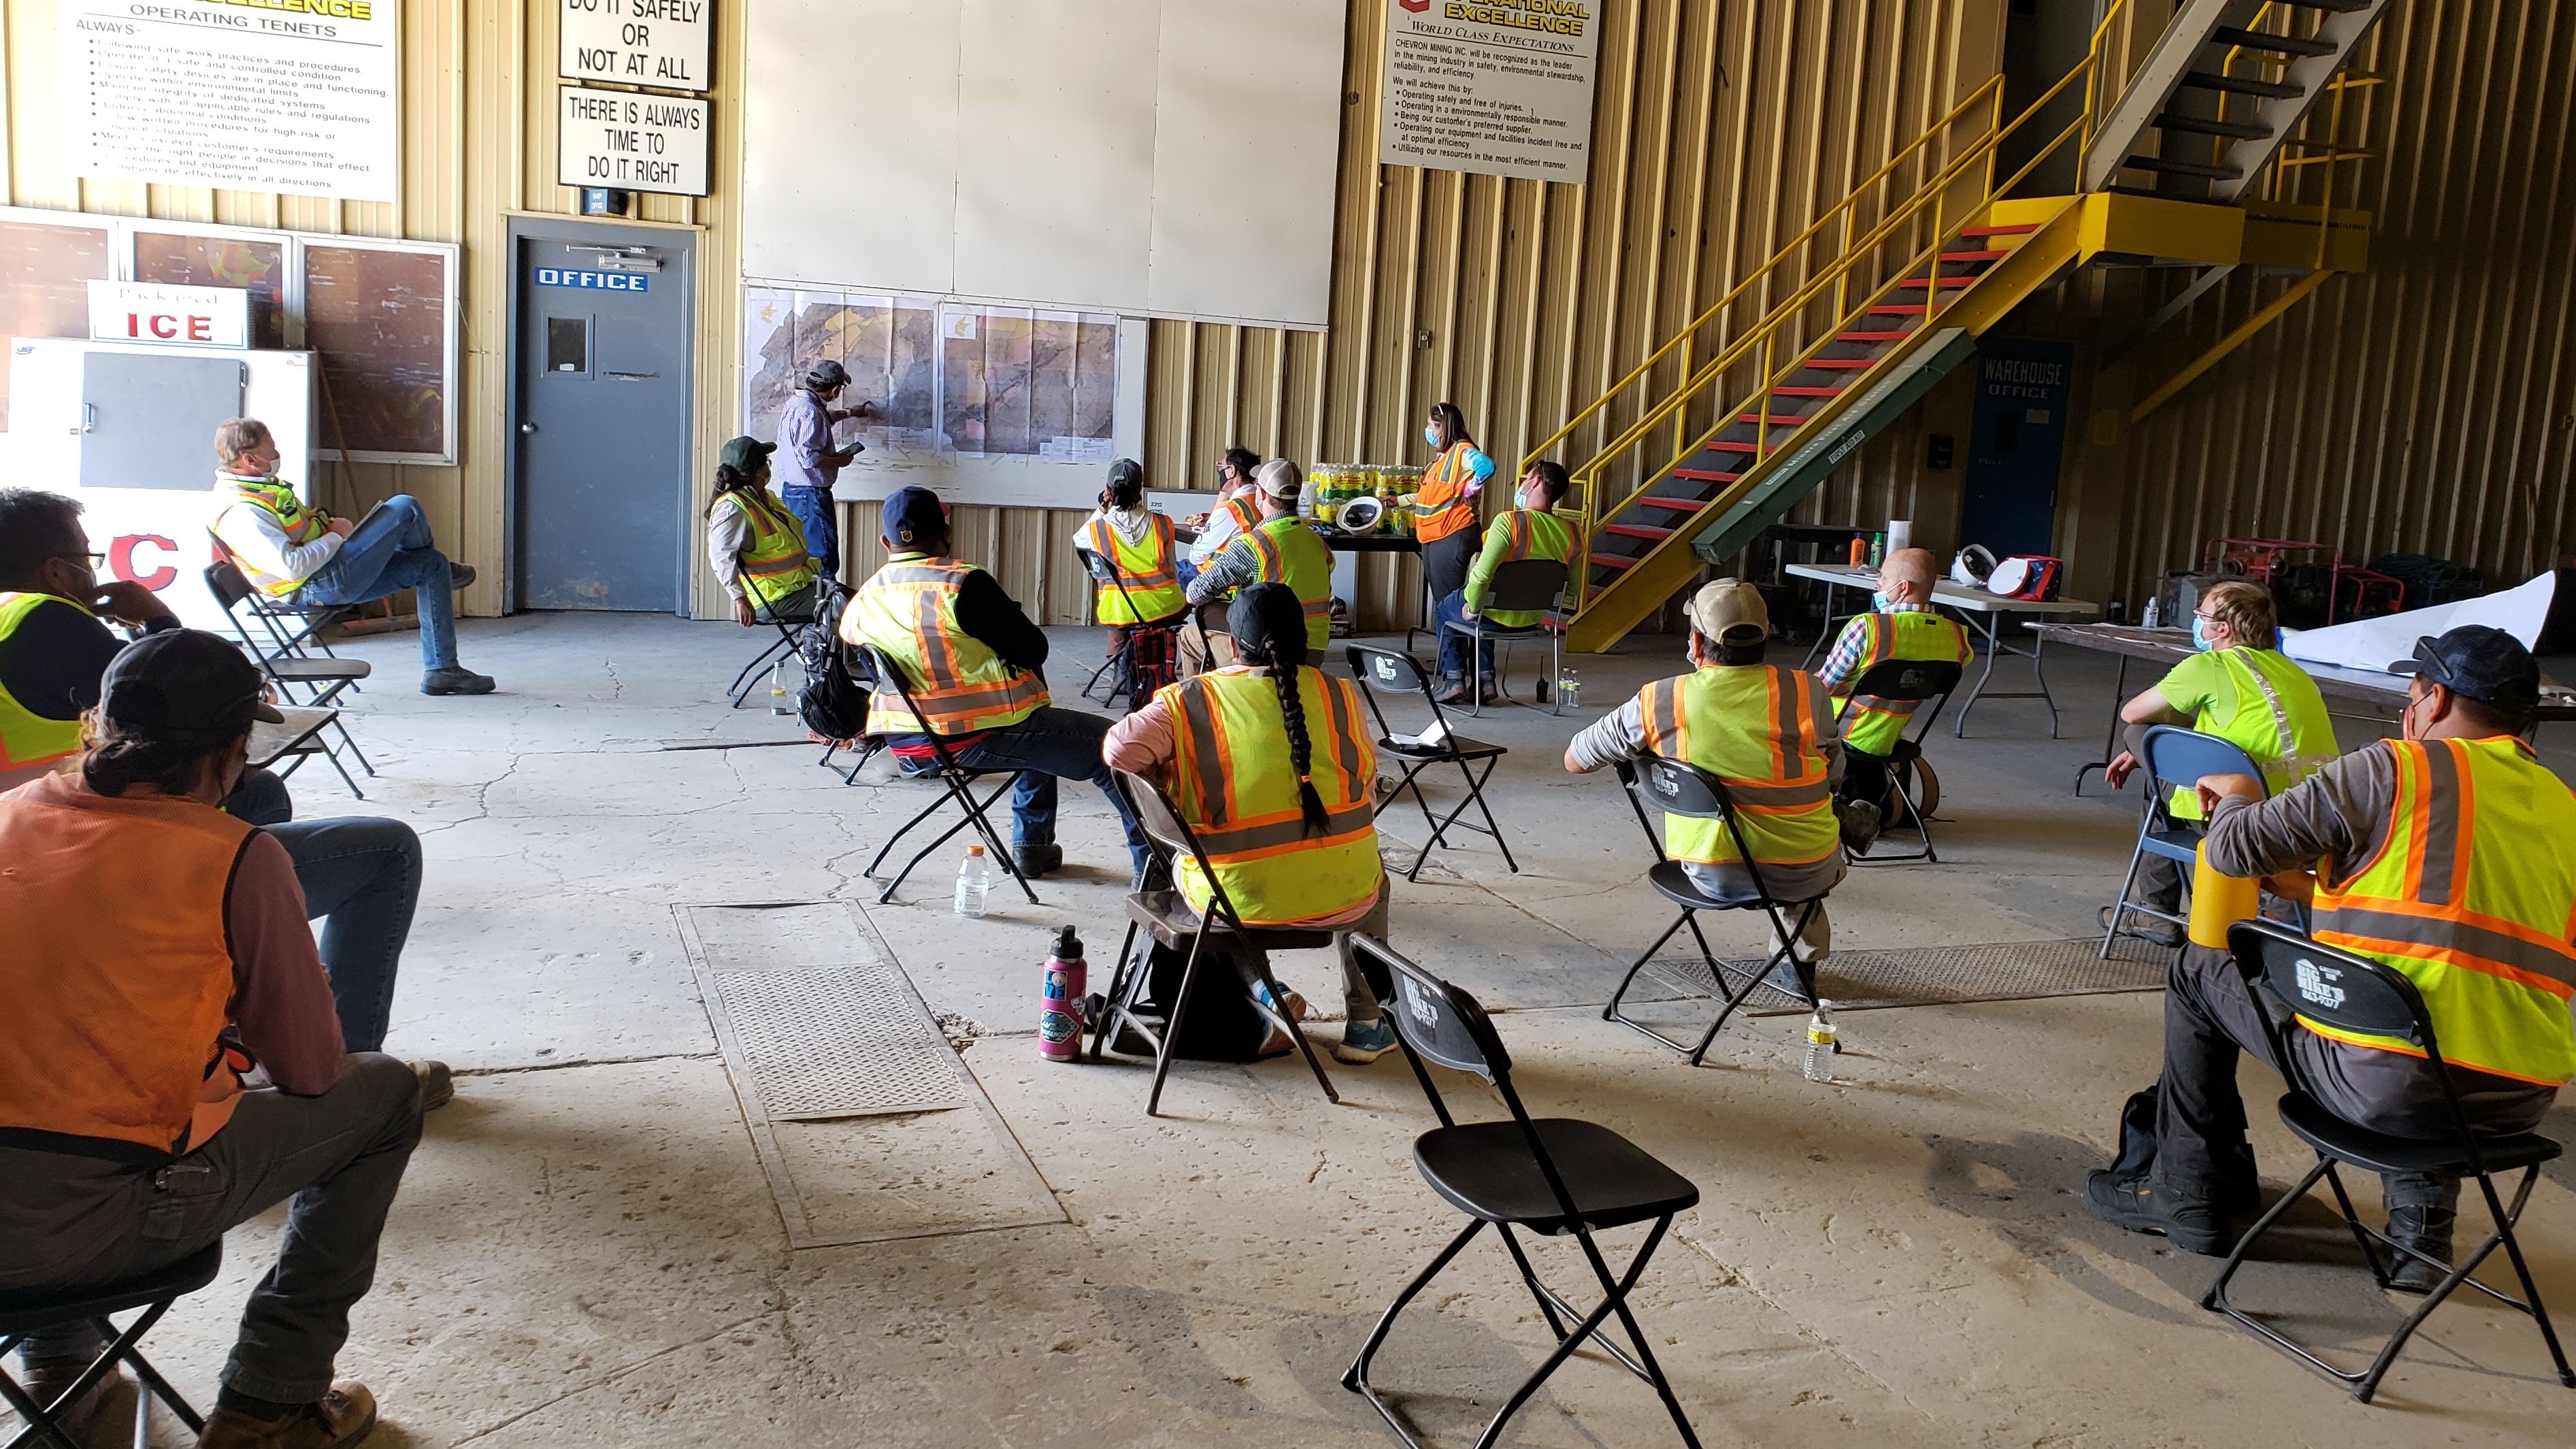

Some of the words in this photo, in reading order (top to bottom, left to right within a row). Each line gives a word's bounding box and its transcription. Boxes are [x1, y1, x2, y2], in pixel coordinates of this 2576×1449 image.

[130, 4, 248, 27] OPERATING
[258, 18, 337, 37] TENETS
[632, 0, 701, 24] SAFELY
[1444, 3, 1583, 37] EXCELLENCE
[622, 22, 649, 47] OR
[219, 54, 269, 63] practices
[578, 47, 618, 73] NOT
[626, 53, 648, 76] AT
[657, 56, 691, 81] ALL
[1395, 50, 1400, 58] in
[1404, 51, 1413, 60] the
[1417, 53, 1437, 64] mining
[1440, 56, 1466, 68] industry
[1468, 59, 1474, 68] in
[1501, 65, 1545, 76] environmental
[1396, 39, 1427, 50] CHEVRON
[1430, 44, 1452, 54] MINING
[1470, 49, 1480, 57] will
[1483, 50, 1490, 59] be
[1493, 54, 1528, 64] recognized
[1541, 59, 1550, 67] the
[1553, 60, 1572, 69] leader
[292, 71, 340, 80] condition
[1393, 76, 1403, 85] We
[1420, 81, 1445, 90] achieve
[1449, 84, 1460, 93] this
[188, 82, 265, 93] environmental
[271, 88, 298, 97] limits
[269, 79, 297, 87] place
[328, 84, 389, 97] functioning.
[1402, 90, 1434, 102] Operating
[1437, 95, 1457, 105] safely
[1474, 99, 1487, 107] free
[220, 94, 274, 104] dedicated
[281, 101, 325, 110] systems
[1402, 100, 1433, 113] Operating
[1436, 104, 1442, 112] in
[1451, 107, 1501, 121] environmentally
[1504, 114, 1540, 124] responsible
[312, 114, 369, 123] regulations
[569, 96, 617, 122] THERE
[625, 102, 638, 124] IS
[644, 104, 700, 131] ALWAYS
[1401, 111, 1419, 122] Being
[1474, 121, 1504, 131] preferred
[274, 128, 295, 137] high
[605, 129, 639, 152] TIME
[646, 133, 665, 155] TO
[1400, 122, 1432, 135] Operating
[1449, 129, 1481, 139] equipment
[1499, 133, 1525, 144] facilities
[1528, 136, 1552, 147] incident
[1555, 139, 1568, 148] free
[1411, 135, 1435, 144] optimal
[257, 156, 307, 166] decisions
[338, 163, 369, 171] effect
[265, 148, 333, 159] requirements
[1398, 144, 1423, 155] Utilizing
[1440, 150, 1472, 159] resources
[1474, 152, 1480, 160] in
[1483, 153, 1493, 161] the
[1515, 156, 1540, 166] efficient
[202, 163, 258, 171] equipment
[589, 155, 610, 178] DO
[616, 158, 629, 180] IT
[635, 160, 679, 184] RIGHT
[186, 170, 242, 181] effectively
[280, 178, 331, 187] directions
[539, 269, 644, 291] OFFICE
[127, 313, 212, 342] ICE
[1985, 359, 2063, 385] WAREHOUSE
[1988, 385, 2050, 399] OFFICE
[1831, 447, 1845, 463] FIRST
[1846, 439, 1855, 450] AID
[1854, 432, 1863, 442] KIT
